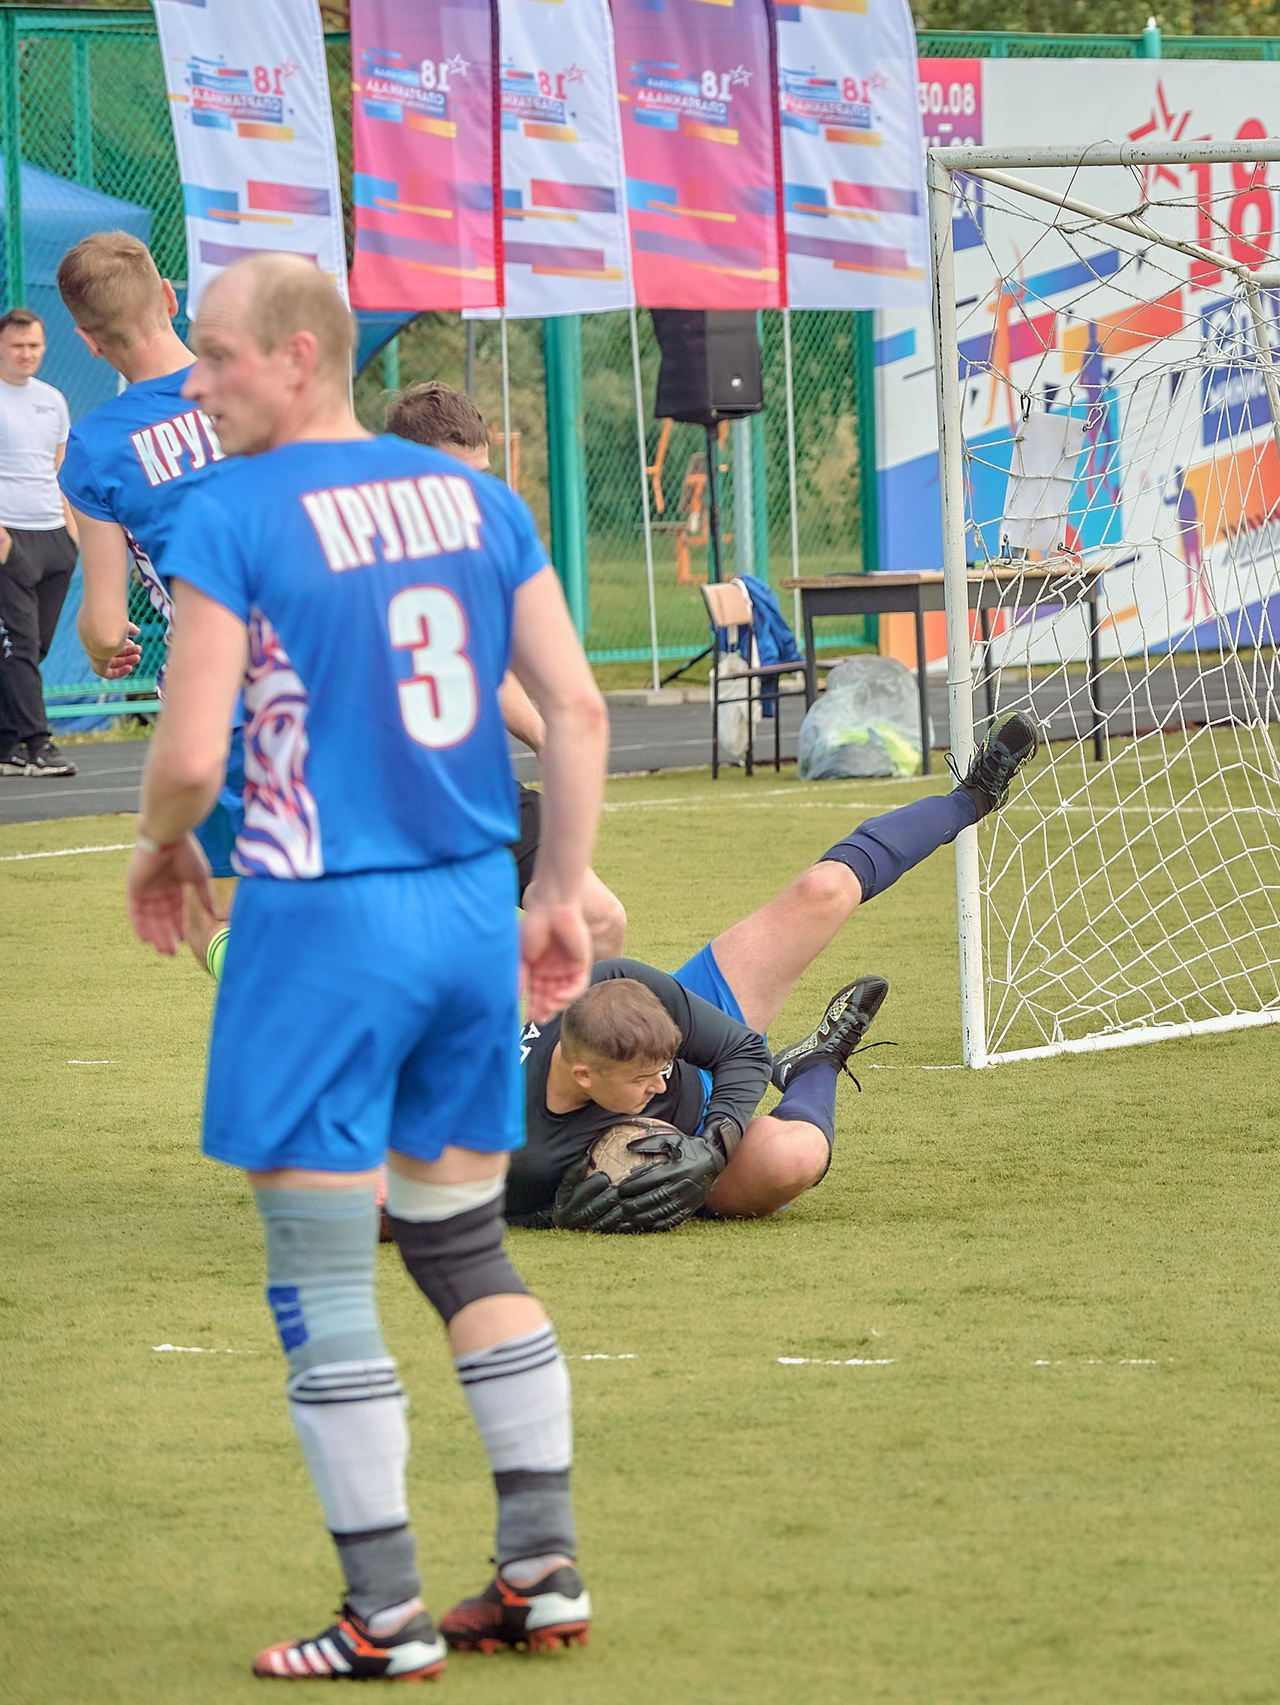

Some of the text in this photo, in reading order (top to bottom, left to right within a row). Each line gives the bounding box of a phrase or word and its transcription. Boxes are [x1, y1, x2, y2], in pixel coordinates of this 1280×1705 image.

[919, 83, 976, 115] 30.08
[1188, 117, 1274, 294] 18
[303, 476, 481, 572] КРУДОР
[387, 584, 480, 749] 3
